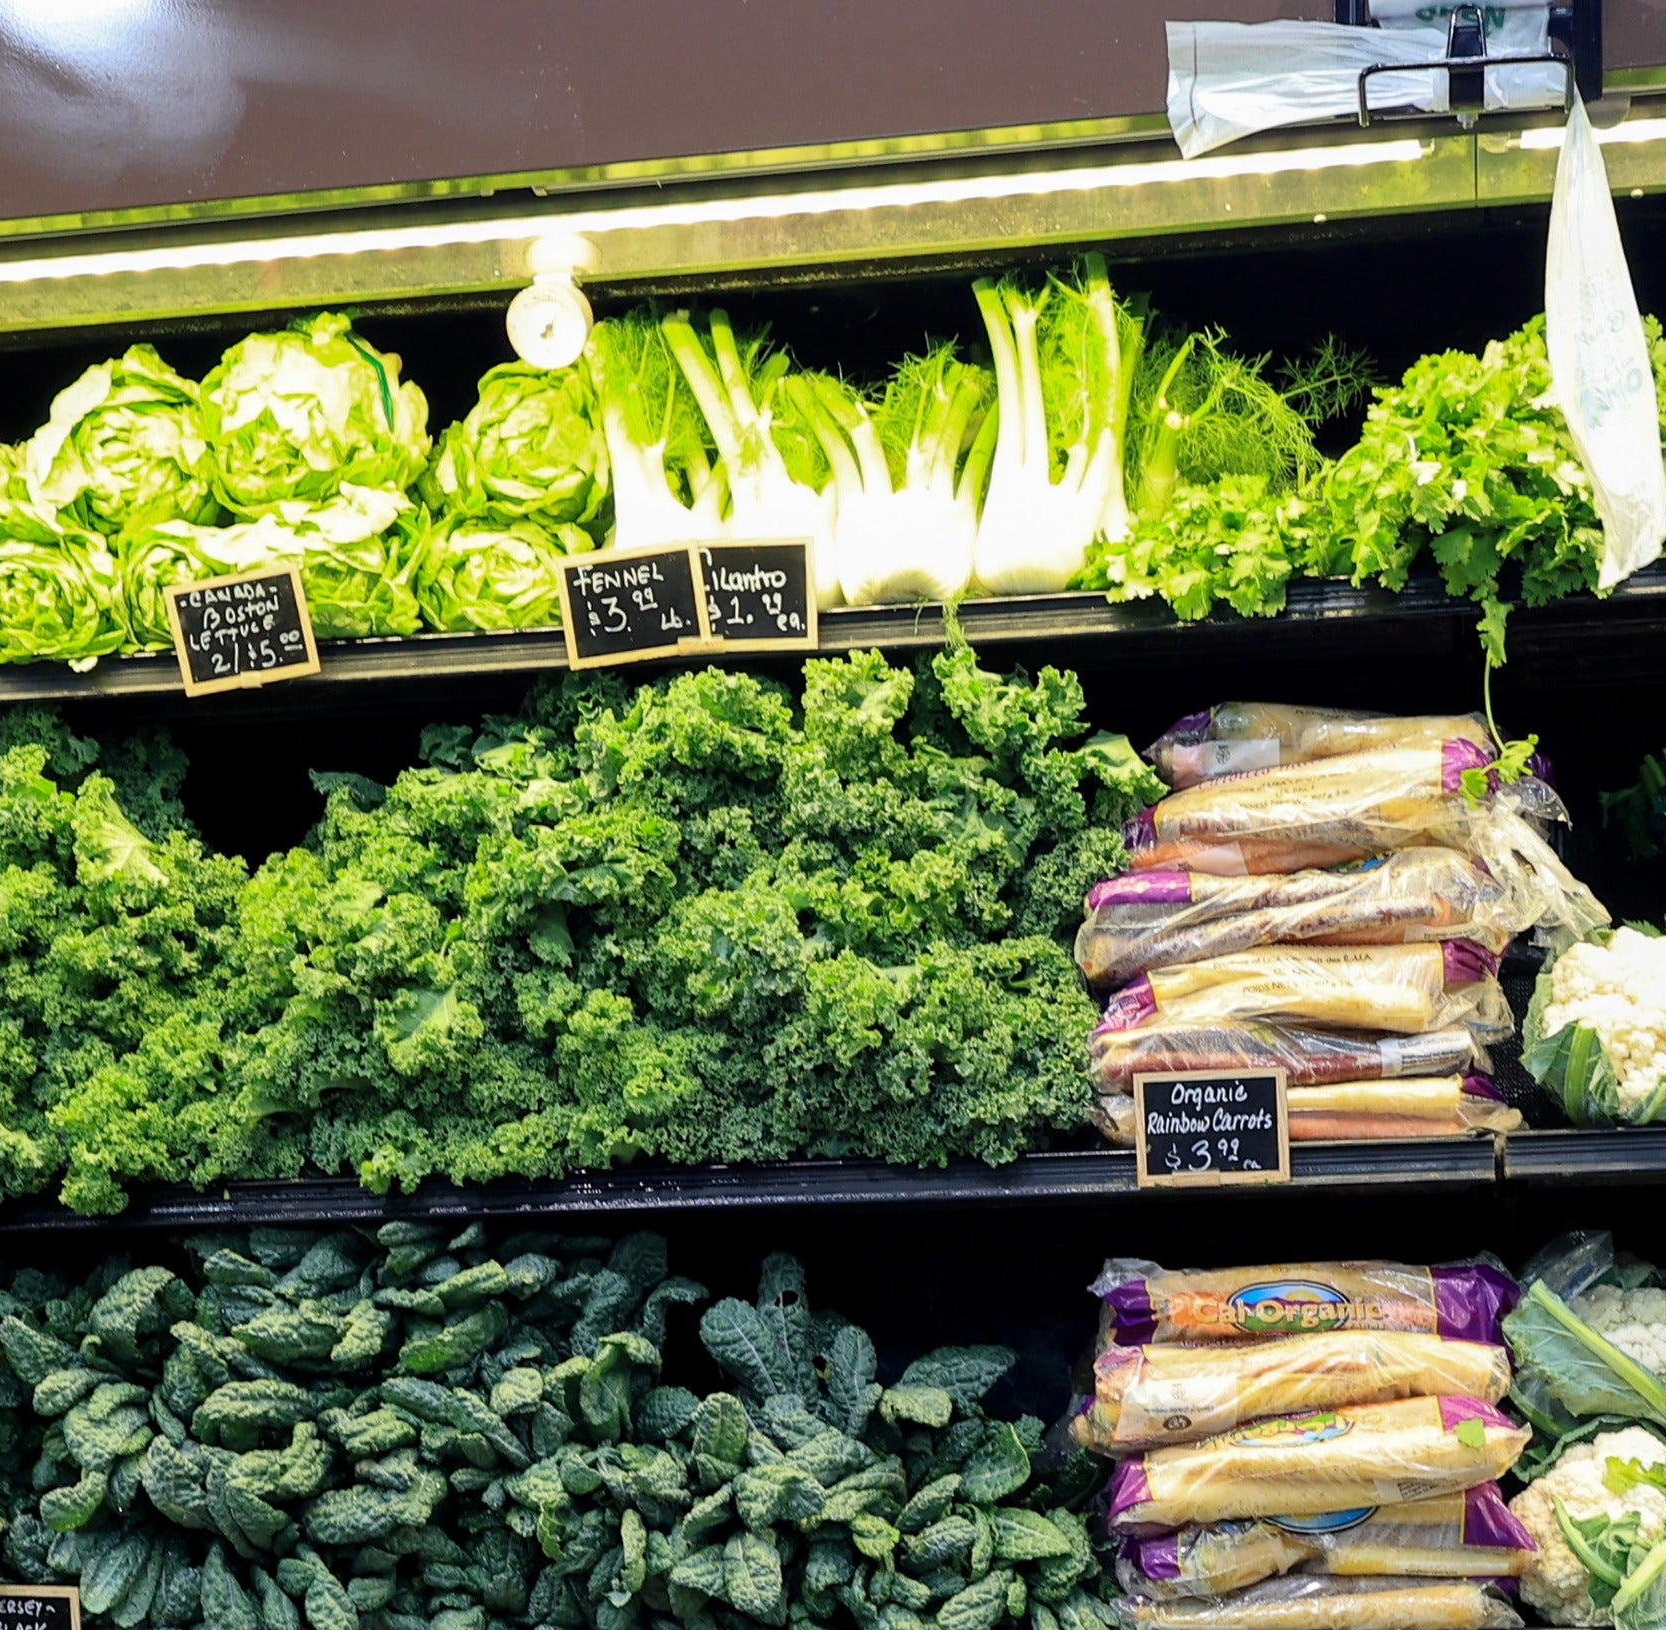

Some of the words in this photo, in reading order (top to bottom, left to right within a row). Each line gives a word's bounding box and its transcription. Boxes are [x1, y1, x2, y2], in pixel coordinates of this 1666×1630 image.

[573, 562, 665, 597] FENNEL
[203, 594, 280, 630] BOSTON
[189, 613, 277, 652] LETTUCE
[1170, 1079, 1249, 1112] Organic
[1146, 1111, 1211, 1136] Rainbow
[1211, 1106, 1273, 1133] Carrots
